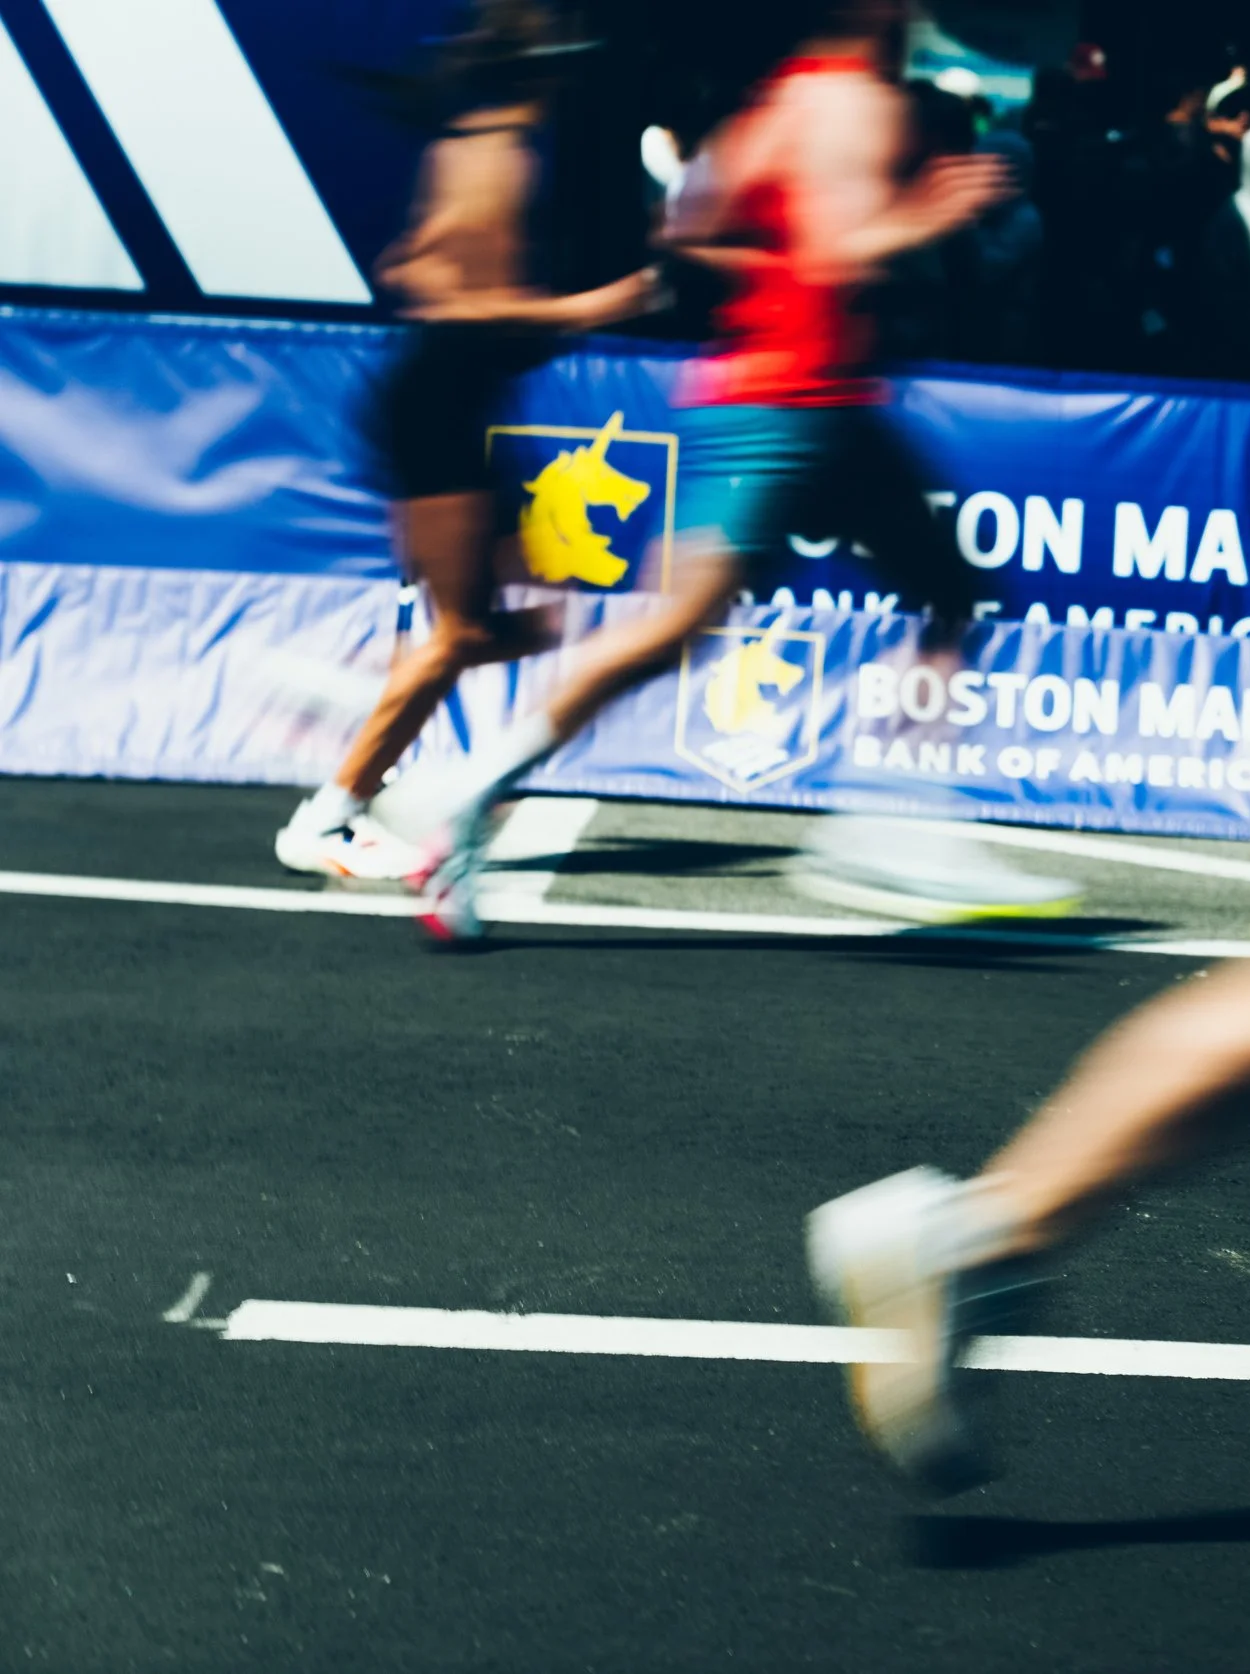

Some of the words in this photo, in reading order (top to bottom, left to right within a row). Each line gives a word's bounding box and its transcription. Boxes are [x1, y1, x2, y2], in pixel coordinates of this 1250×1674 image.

[857, 663, 1120, 735] BOSTON
[853, 735, 986, 776] BANK
[997, 746, 1061, 780] OF
